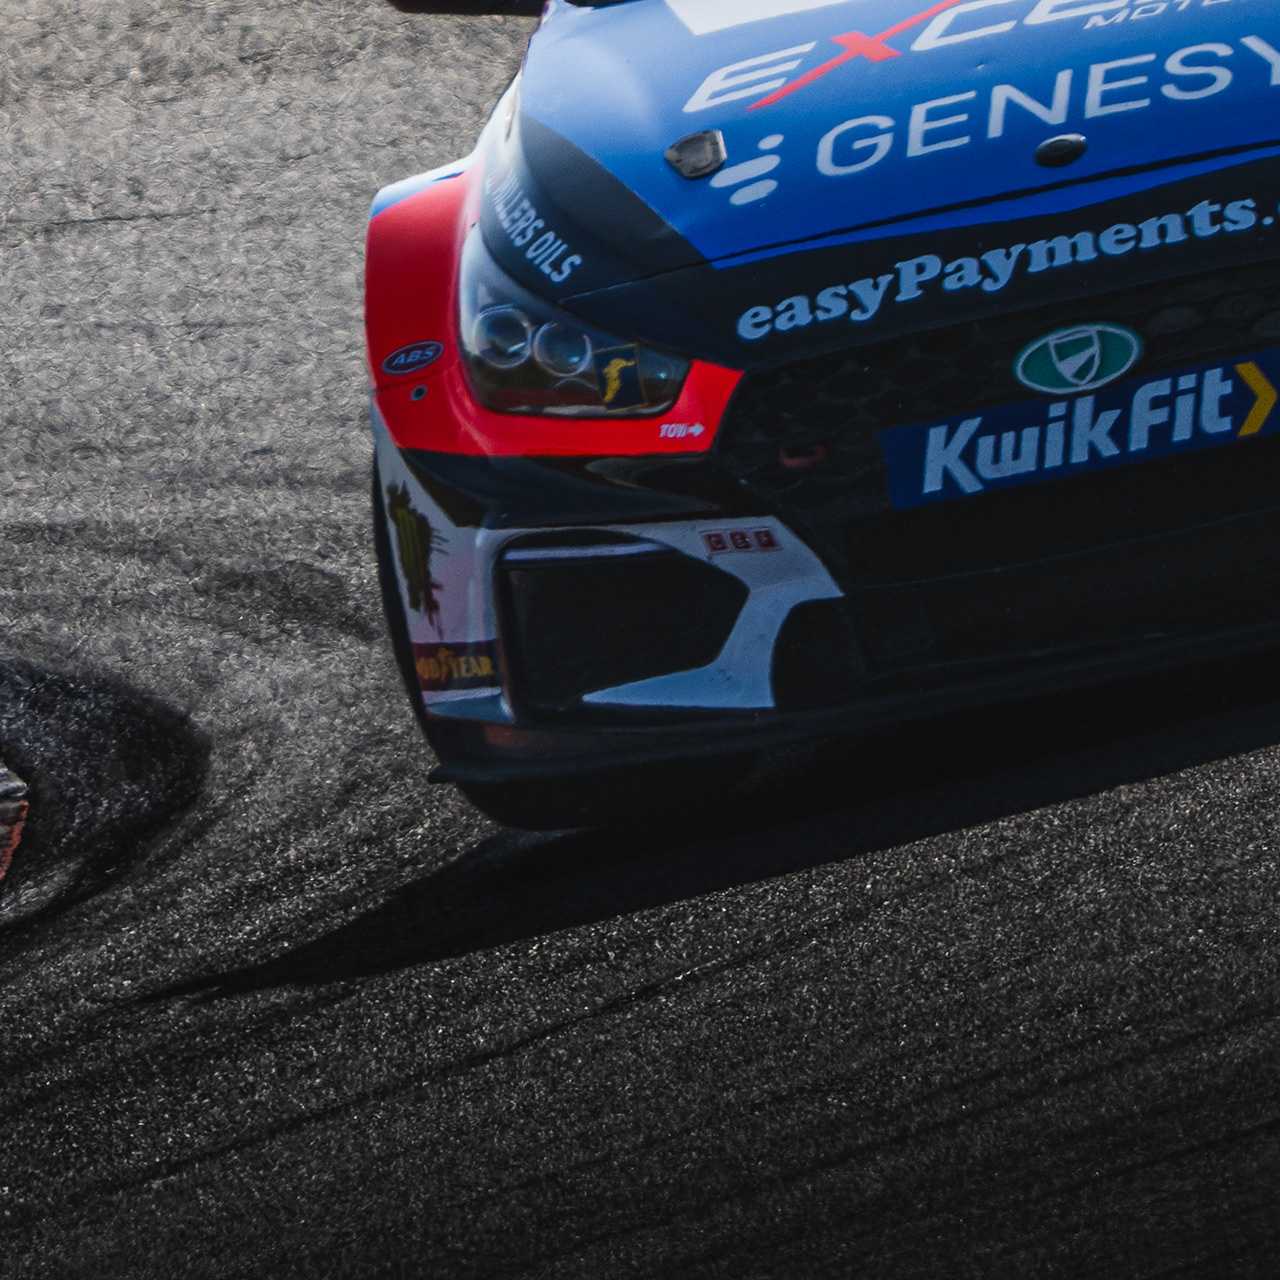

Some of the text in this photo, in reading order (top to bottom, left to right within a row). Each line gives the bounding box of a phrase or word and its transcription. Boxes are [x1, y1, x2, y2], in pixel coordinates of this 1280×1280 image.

[525, 231, 583, 282] OILS
[391, 345, 437, 367] ABS
[660, 423, 687, 438] TOW
